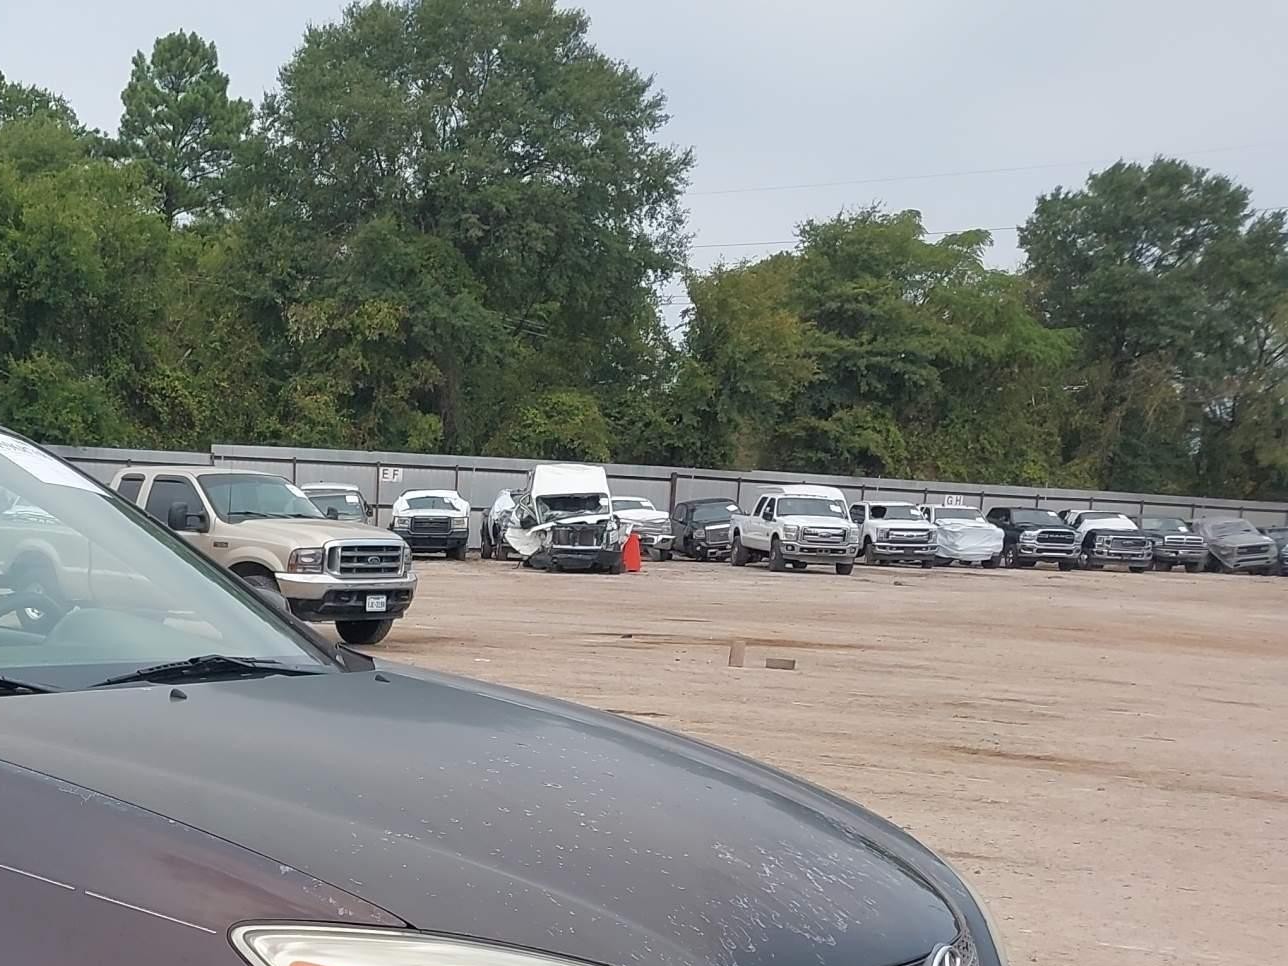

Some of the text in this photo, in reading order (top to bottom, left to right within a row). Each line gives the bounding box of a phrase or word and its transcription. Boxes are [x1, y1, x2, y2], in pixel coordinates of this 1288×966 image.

[382, 469, 400, 481] E F
[946, 495, 962, 506] G H
